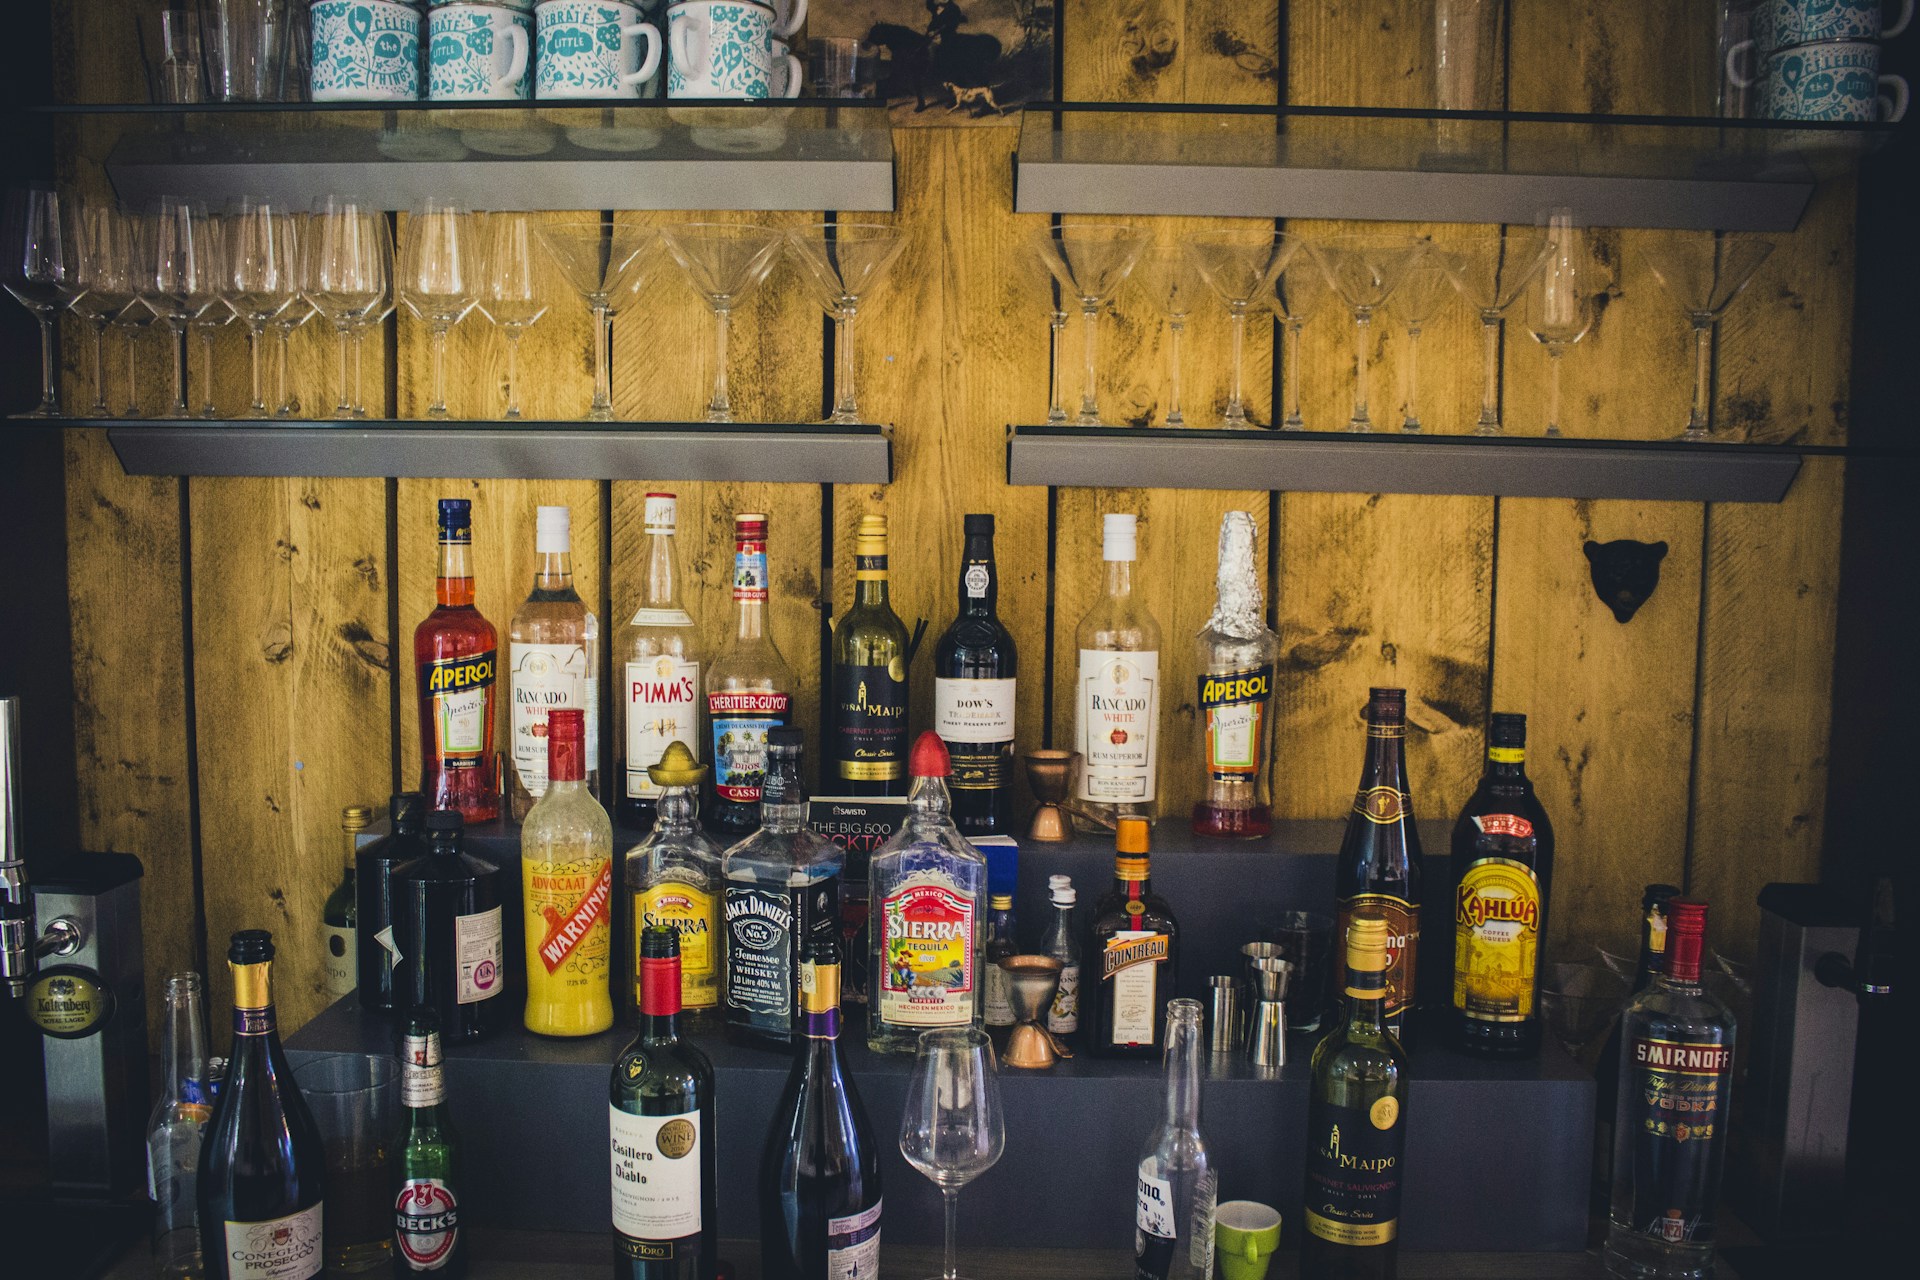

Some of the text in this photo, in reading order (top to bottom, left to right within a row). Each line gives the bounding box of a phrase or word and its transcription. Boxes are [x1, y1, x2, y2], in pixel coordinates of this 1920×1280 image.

[379, 40, 398, 53] the
[554, 35, 585, 48] LITTLE
[371, 66, 412, 86] THINGS
[1810, 80, 1829, 93] the
[1847, 80, 1872, 91] LITTL
[429, 660, 493, 691] APEROL
[516, 687, 567, 704] RANCADO
[632, 676, 694, 703] PIMM'S
[1202, 674, 1269, 703] APEROL
[957, 698, 993, 708] DOW'S
[1092, 694, 1146, 712] RANCADO
[1104, 713, 1135, 723] WHITE
[1092, 752, 1143, 760] RUM SUPERIOR
[735, 762, 760, 772] DIJON
[841, 808, 866, 816] SAVISTO
[812, 822, 891, 834] THE BIG 500
[531, 876, 588, 891] ADVOCAAT
[725, 900, 750, 921] JACK
[750, 895, 794, 931] DANIEL'S
[1457, 884, 1539, 930] KAHLÚA
[543, 870, 611, 965] WARNINKS
[887, 912, 966, 941] SIERRA
[1482, 929, 1510, 937] COFFEE
[908, 942, 949, 951] TEQUILA
[1480, 935, 1511, 943] LIQUEUR
[735, 947, 780, 965] Tennessee
[1105, 940, 1165, 973] COINTREAU
[735, 965, 779, 979] WHISKEY
[742, 976, 756, 986] Litre
[757, 979, 771, 988] 40%
[38, 998, 91, 1014] Kaltenberg
[1637, 1043, 1729, 1069] SMIRNOFF
[1645, 1093, 1717, 1112] VODKA
[661, 1132, 692, 1144] WINE
[612, 1137, 653, 1161] Casillero
[623, 1159, 634, 1169] del
[615, 1163, 647, 1184] Diablo
[1322, 1203, 1348, 1217] Classic
[396, 1211, 457, 1230] BECK'S
[232, 1231, 321, 1261] CONEGLIANO
[245, 1246, 314, 1270] PROSECCO
